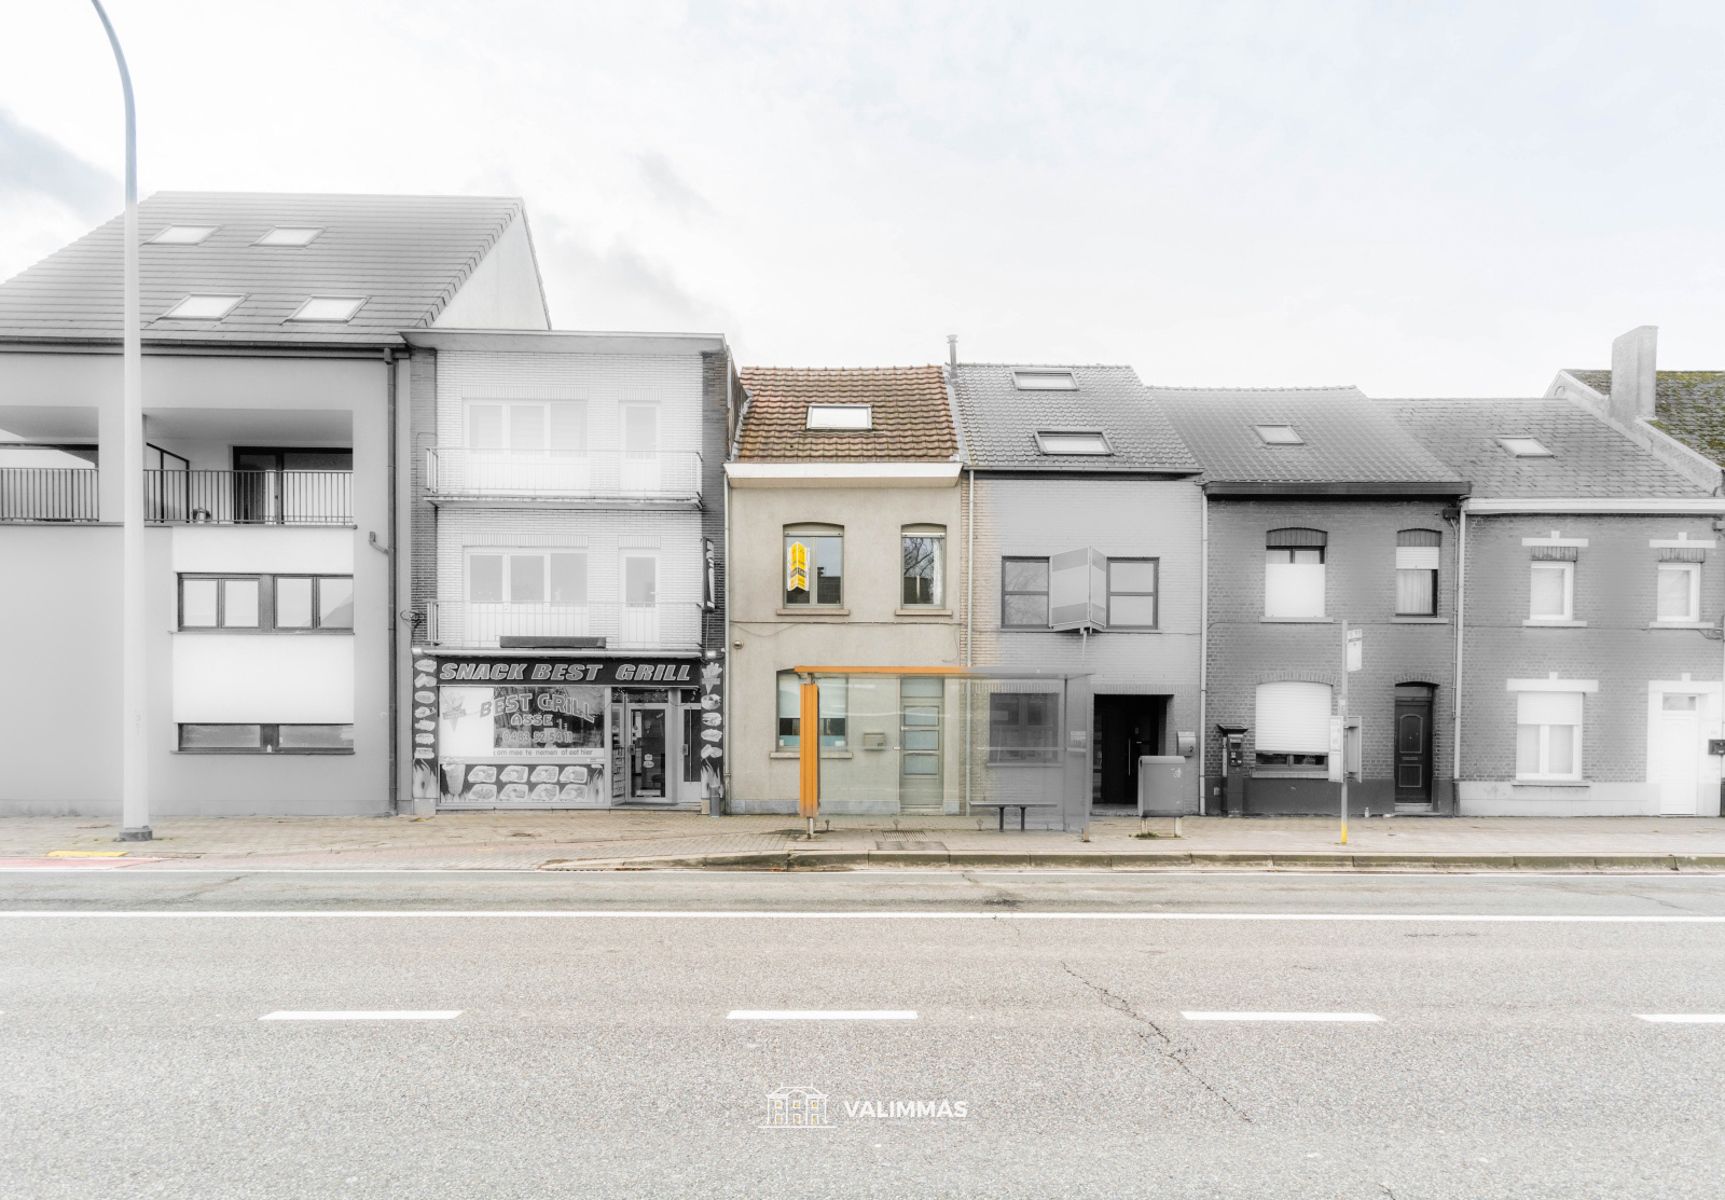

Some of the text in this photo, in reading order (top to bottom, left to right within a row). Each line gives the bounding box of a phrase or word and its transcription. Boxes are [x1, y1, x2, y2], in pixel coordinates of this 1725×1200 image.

[440, 663, 690, 681] SNACK BEST GRILL
[480, 693, 595, 724] BEST GRILL
